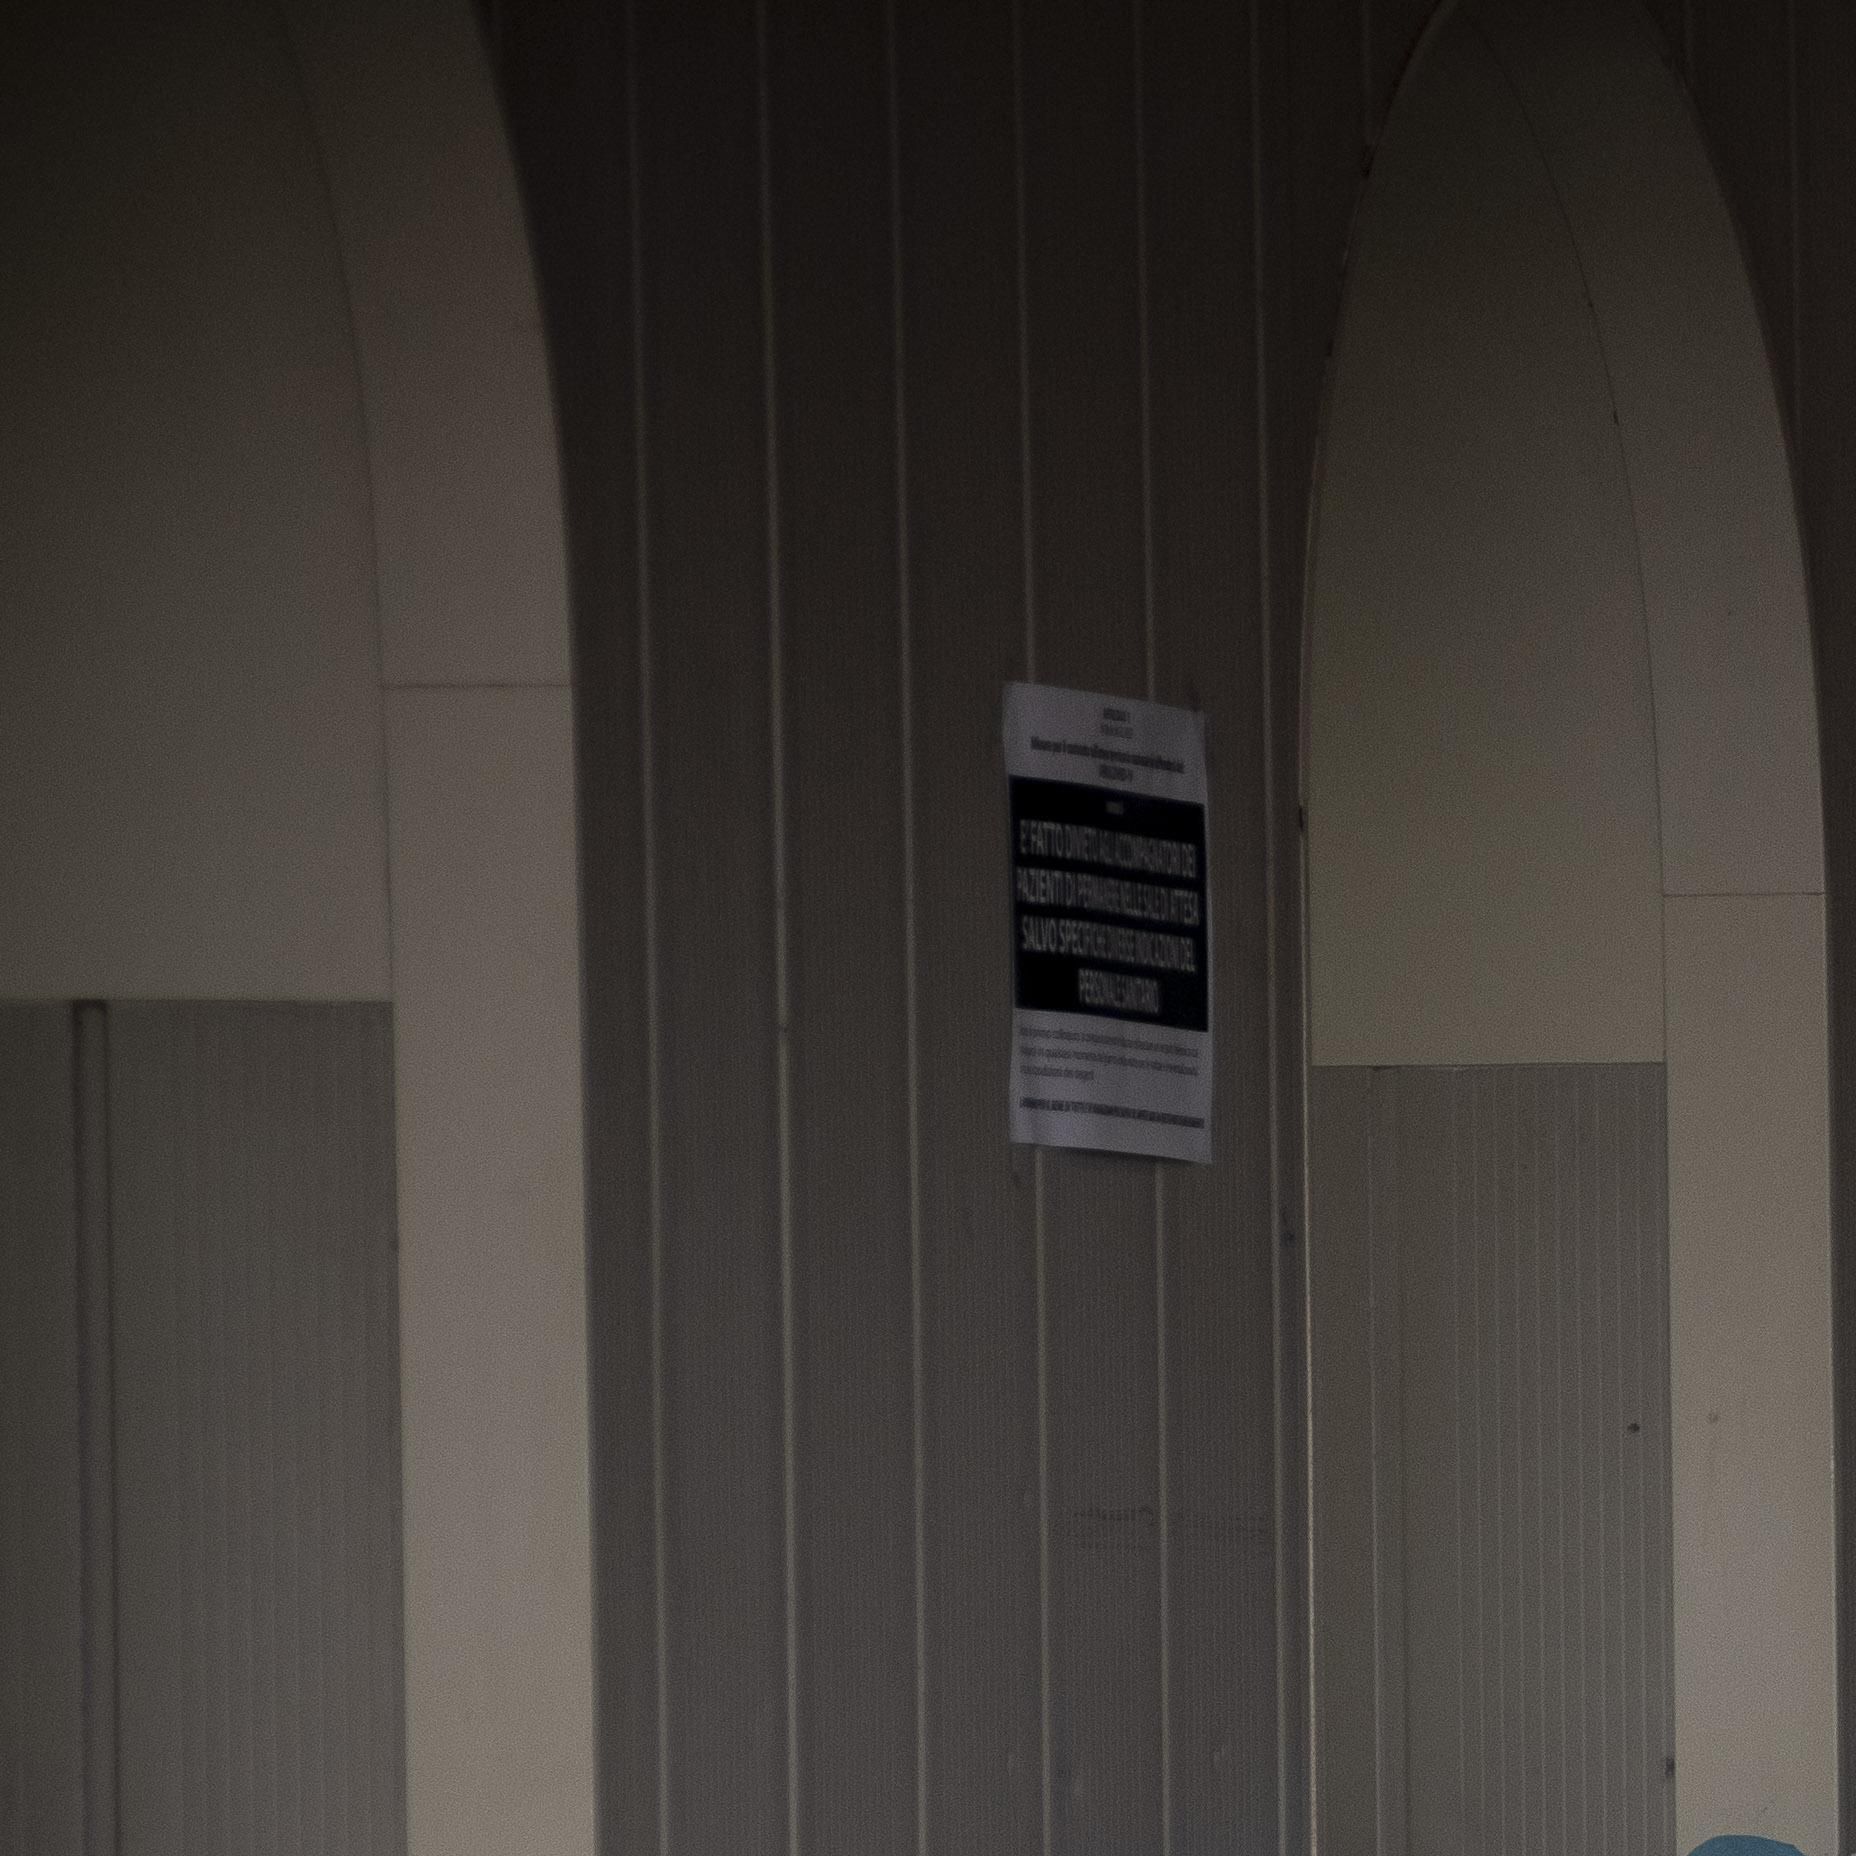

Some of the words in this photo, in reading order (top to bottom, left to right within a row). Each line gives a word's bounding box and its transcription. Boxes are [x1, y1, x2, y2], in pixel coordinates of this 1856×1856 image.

[1030, 820, 1062, 860] FATTO
[1016, 865, 1062, 907] PAZIENTI
[1065, 872, 1075, 908] DI
[1170, 887, 1199, 926] ATTESA
[1022, 914, 1057, 954] SALVO
[1059, 919, 1106, 961] SPECIFICHE
[1180, 937, 1195, 974] DEL
[1078, 967, 1120, 1007] PERSONALE
